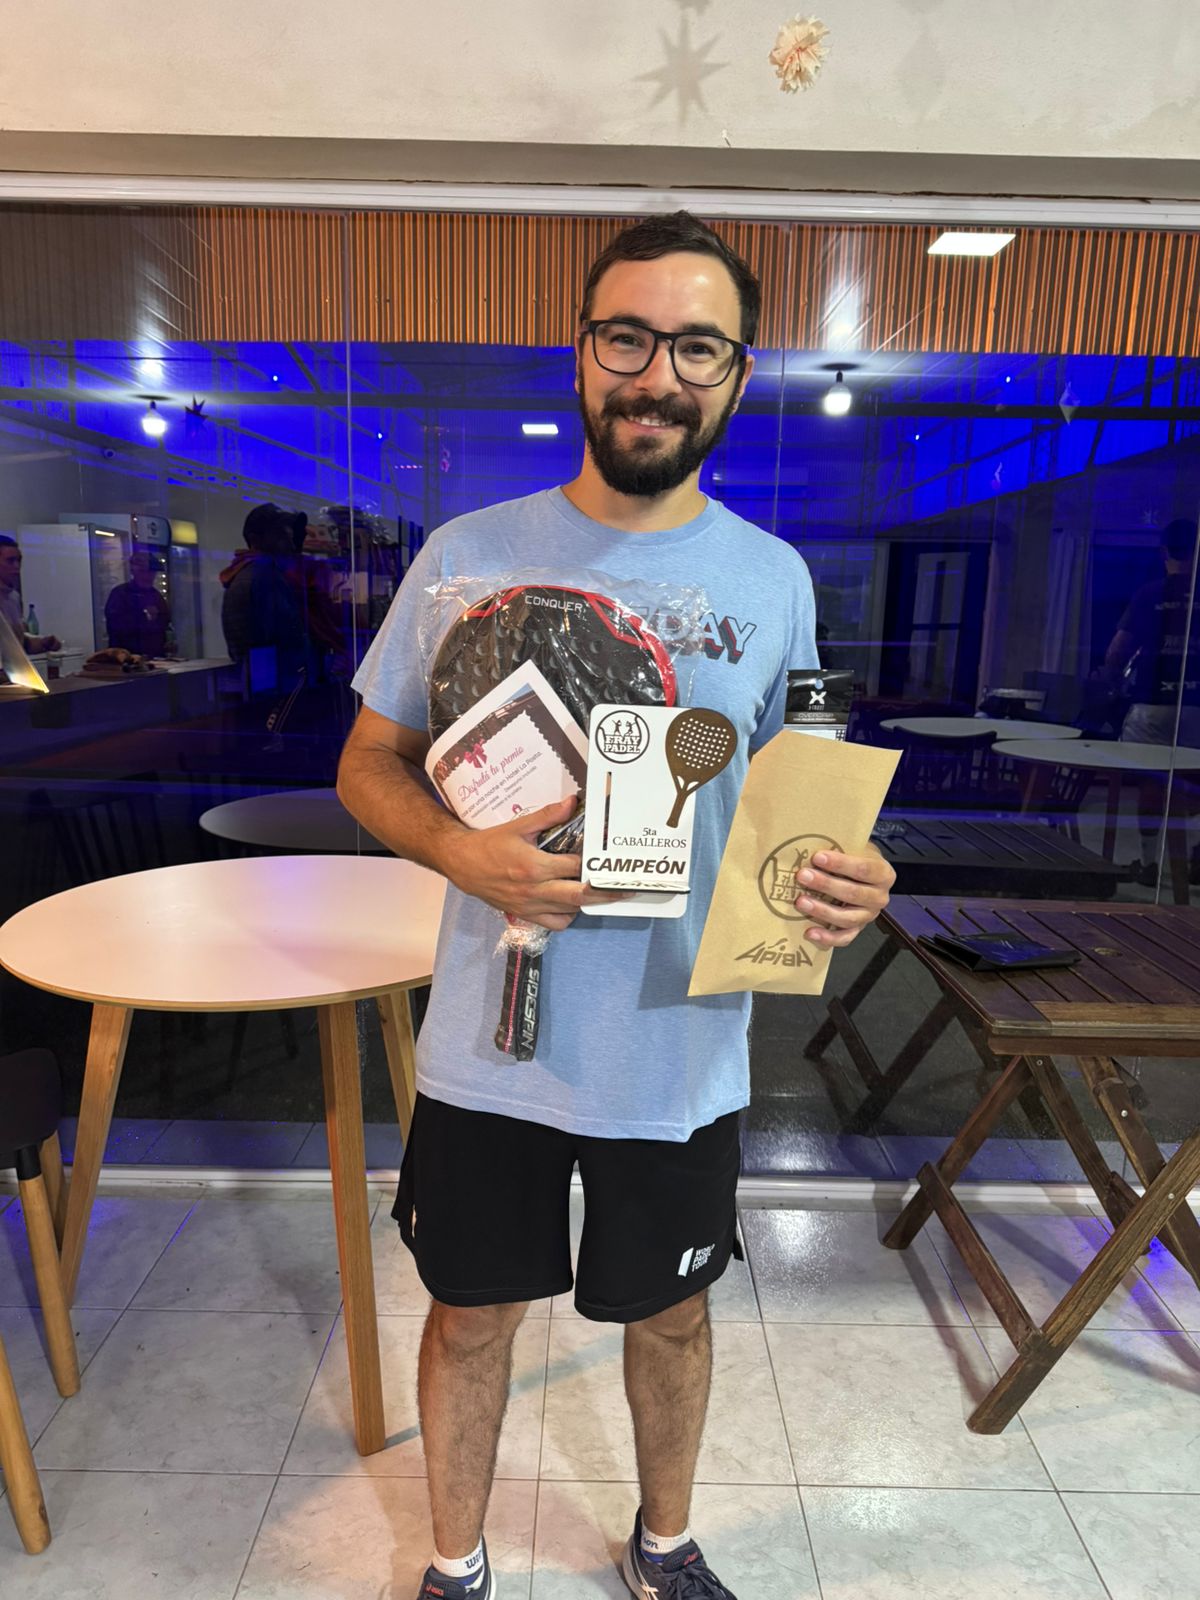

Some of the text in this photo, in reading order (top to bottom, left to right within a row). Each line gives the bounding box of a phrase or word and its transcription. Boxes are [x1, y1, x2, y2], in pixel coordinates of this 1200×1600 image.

[525, 595, 583, 613] CONQUER
[604, 735, 641, 745] FRAY
[604, 744, 641, 753] PADEL
[500, 746, 524, 773] premio
[484, 784, 500, 798] noche
[506, 768, 520, 781] Hotel
[642, 827, 657, 836] 5ta
[612, 836, 687, 848] CABALLEROS
[586, 856, 686, 875] CAMPEÓN
[520, 968, 540, 1050] SIDESPIN
